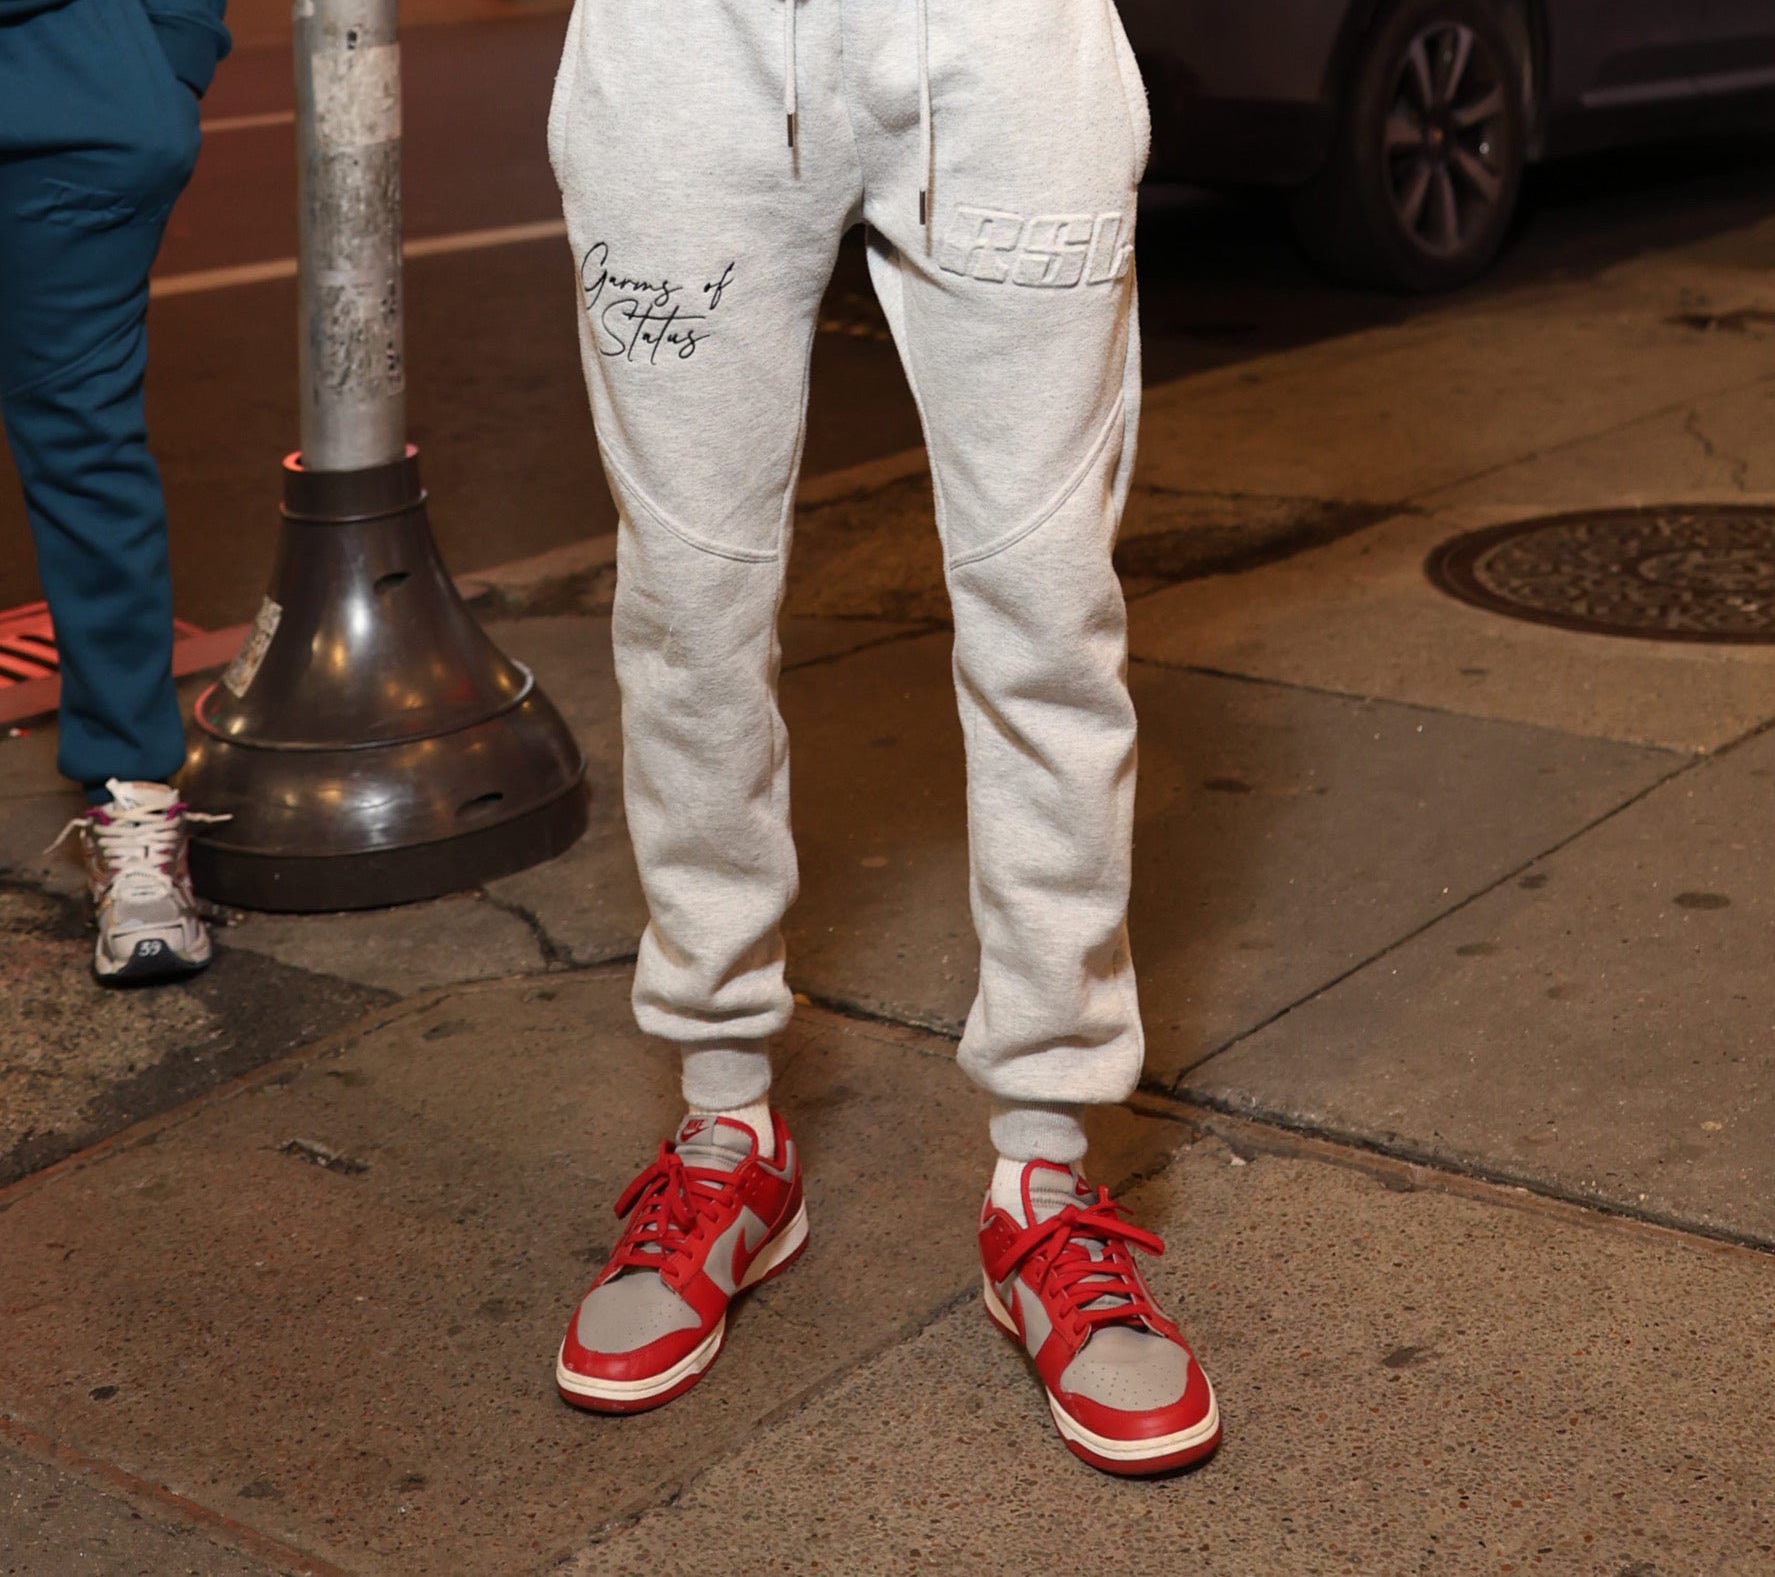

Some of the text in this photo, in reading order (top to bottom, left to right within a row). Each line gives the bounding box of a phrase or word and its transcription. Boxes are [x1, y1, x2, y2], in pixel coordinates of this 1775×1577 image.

[581, 241, 735, 310] Garms of
[600, 298, 711, 366] Status
